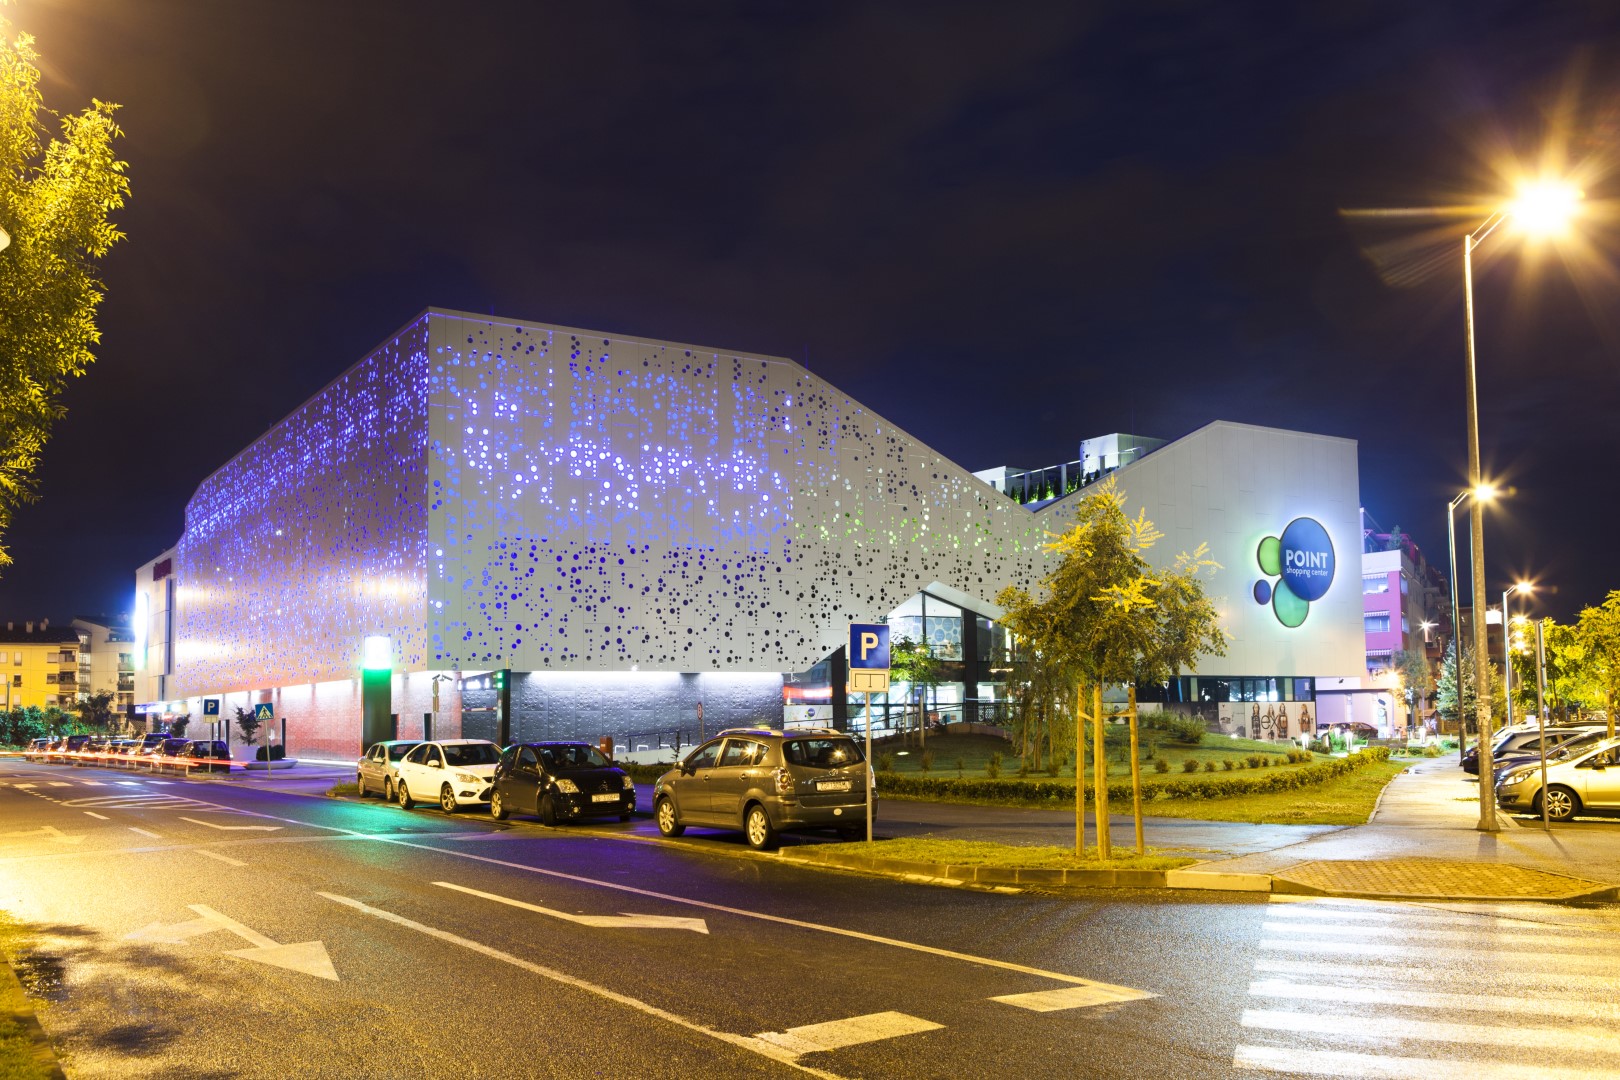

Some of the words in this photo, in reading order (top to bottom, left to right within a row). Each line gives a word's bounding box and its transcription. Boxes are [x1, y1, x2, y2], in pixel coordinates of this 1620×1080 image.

[1285, 549, 1328, 569] POINT
[1286, 565, 1311, 578] shopping
[1311, 569, 1329, 577] center
[861, 632, 879, 661] P
[207, 701, 216, 713] P
